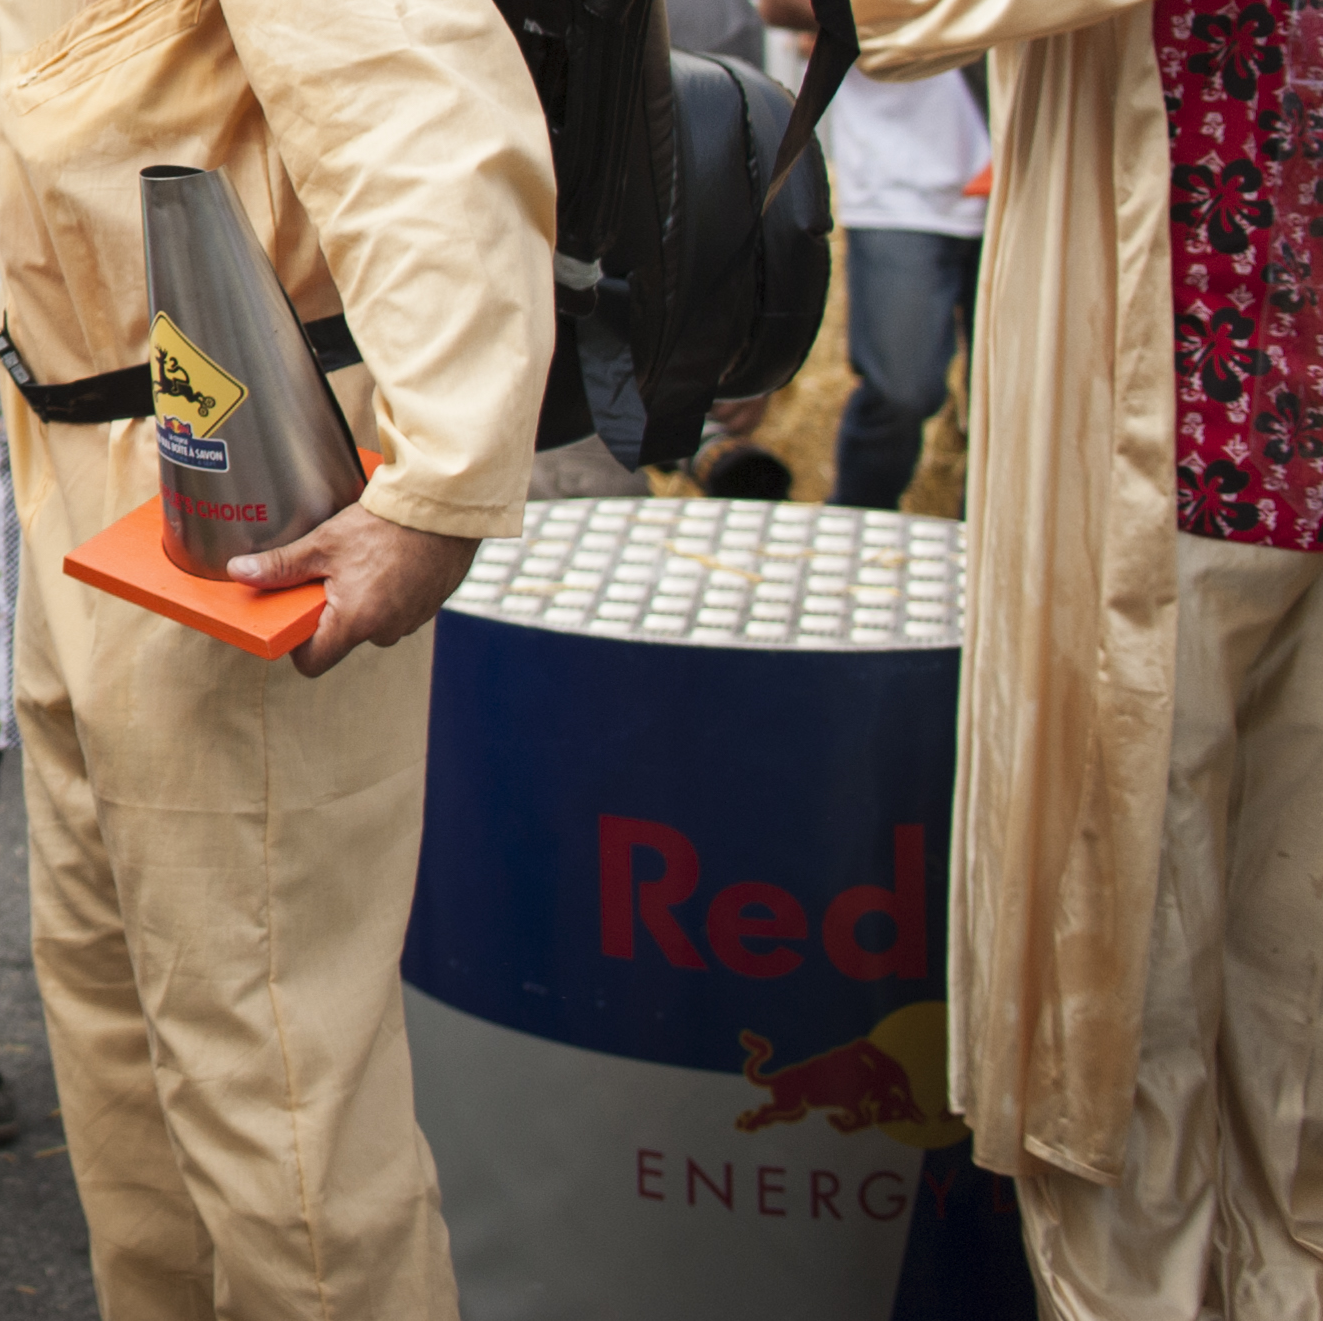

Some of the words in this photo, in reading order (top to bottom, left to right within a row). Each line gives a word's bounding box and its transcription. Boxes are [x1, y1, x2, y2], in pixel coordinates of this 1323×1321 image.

[195, 448, 223, 461] SAVON
[196, 500, 269, 523] CHOICE
[597, 812, 929, 982] Red
[636, 1148, 958, 1223] ENERGY
